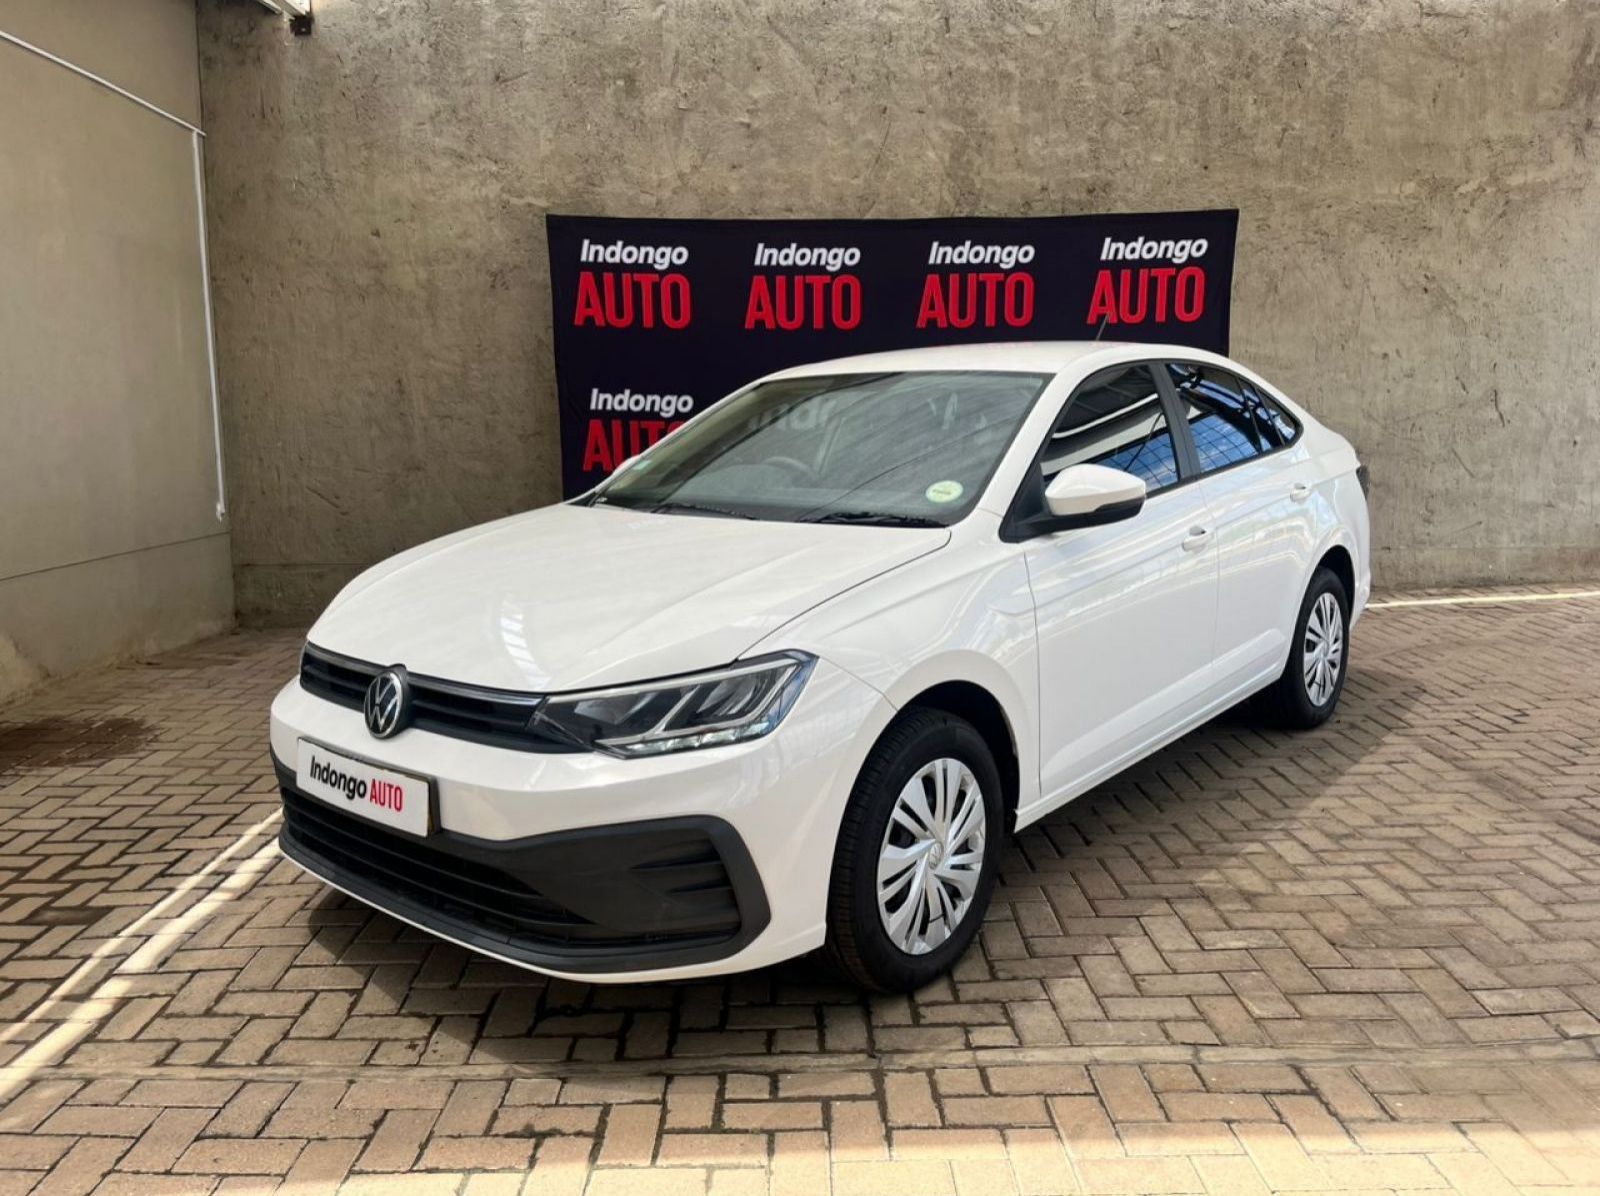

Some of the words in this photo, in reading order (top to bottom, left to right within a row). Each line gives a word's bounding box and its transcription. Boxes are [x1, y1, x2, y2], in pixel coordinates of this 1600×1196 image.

[580, 238, 689, 270] Indongo
[754, 242, 861, 271] Indongo
[928, 240, 1036, 269] Indongo
[1100, 236, 1209, 264] Indongo
[574, 271, 691, 329] AUTO
[744, 274, 862, 330] AUTO
[916, 271, 1035, 329] AUTO
[1087, 266, 1206, 324] AUTO
[589, 387, 694, 418] Indongo
[583, 419, 684, 472] AUT
[310, 755, 367, 800] Indongo
[370, 778, 404, 812] AUTO
